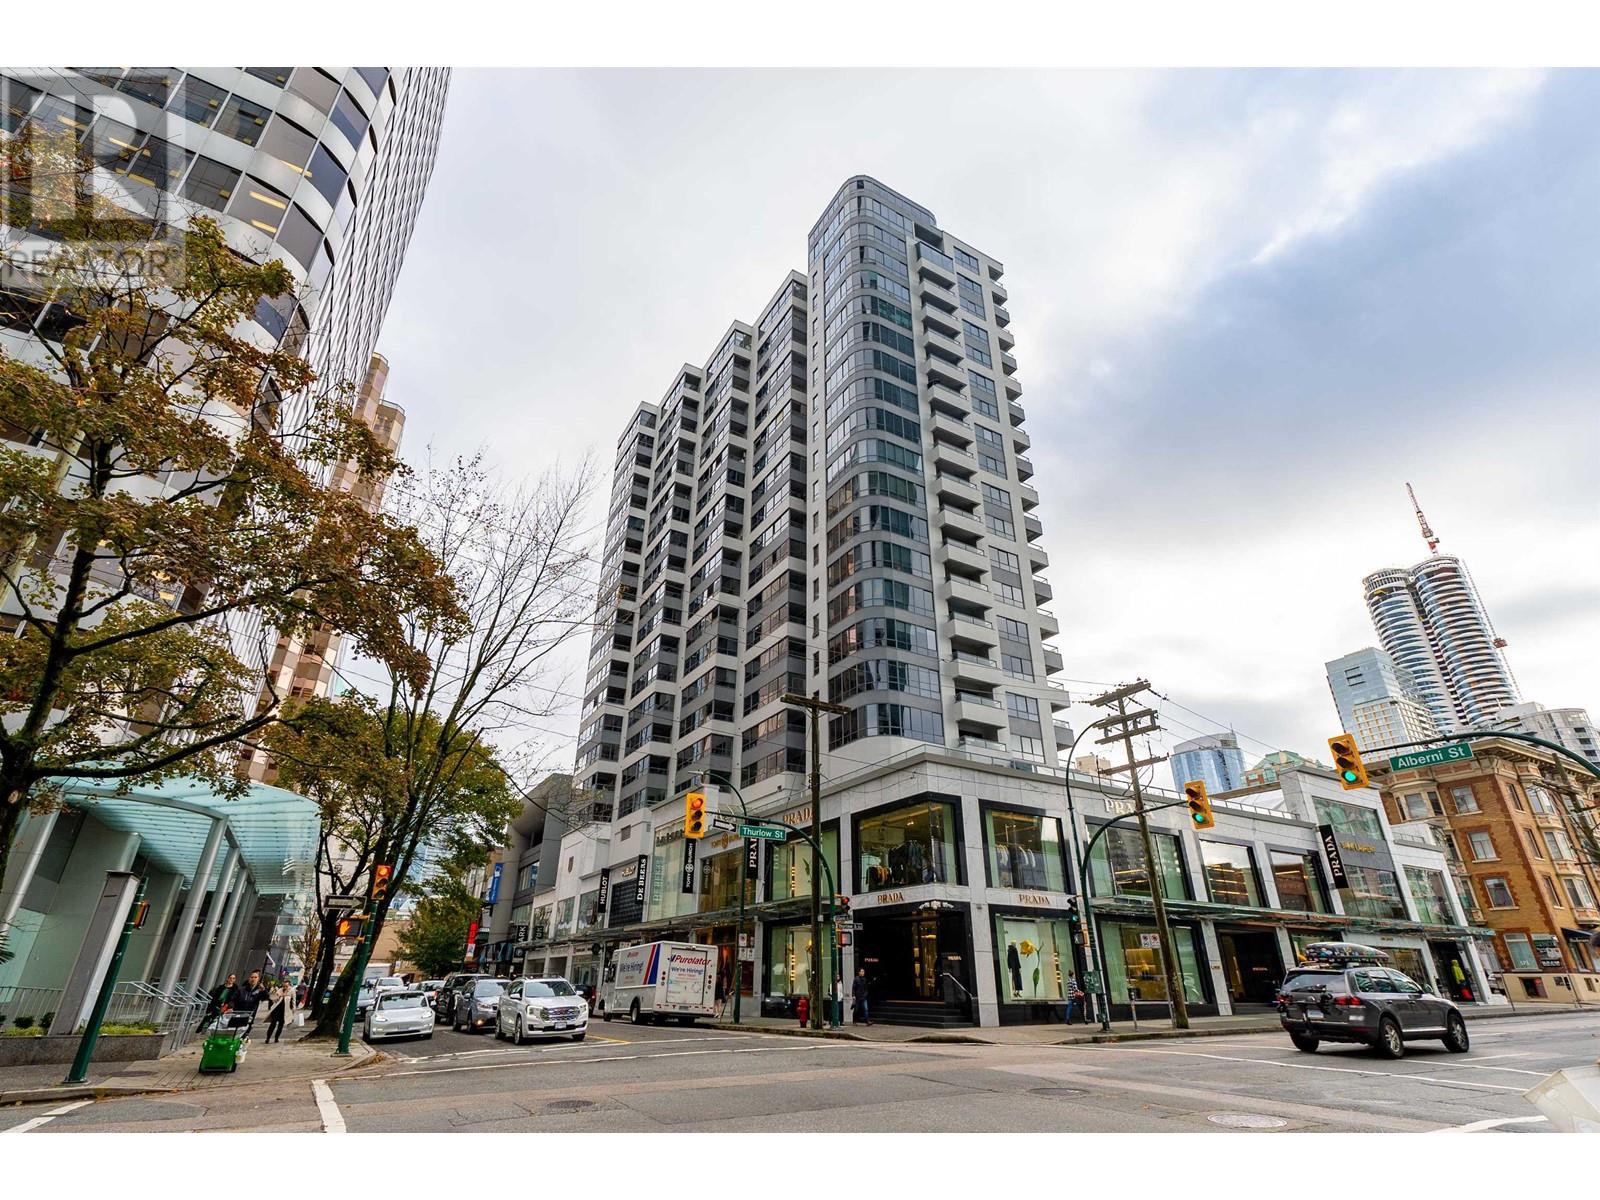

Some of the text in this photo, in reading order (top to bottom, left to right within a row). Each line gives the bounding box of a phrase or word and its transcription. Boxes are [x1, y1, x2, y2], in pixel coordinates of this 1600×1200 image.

[1398, 746, 1465, 768] Alberni St
[742, 827, 784, 839] Thurlow St
[1325, 835, 1343, 876] PRADA
[636, 858, 647, 901] DE BEERS
[599, 876, 608, 905] HUBLOT
[877, 892, 904, 905] PRADA
[1018, 893, 1050, 905] PRADA
[675, 954, 711, 965] Purolator
